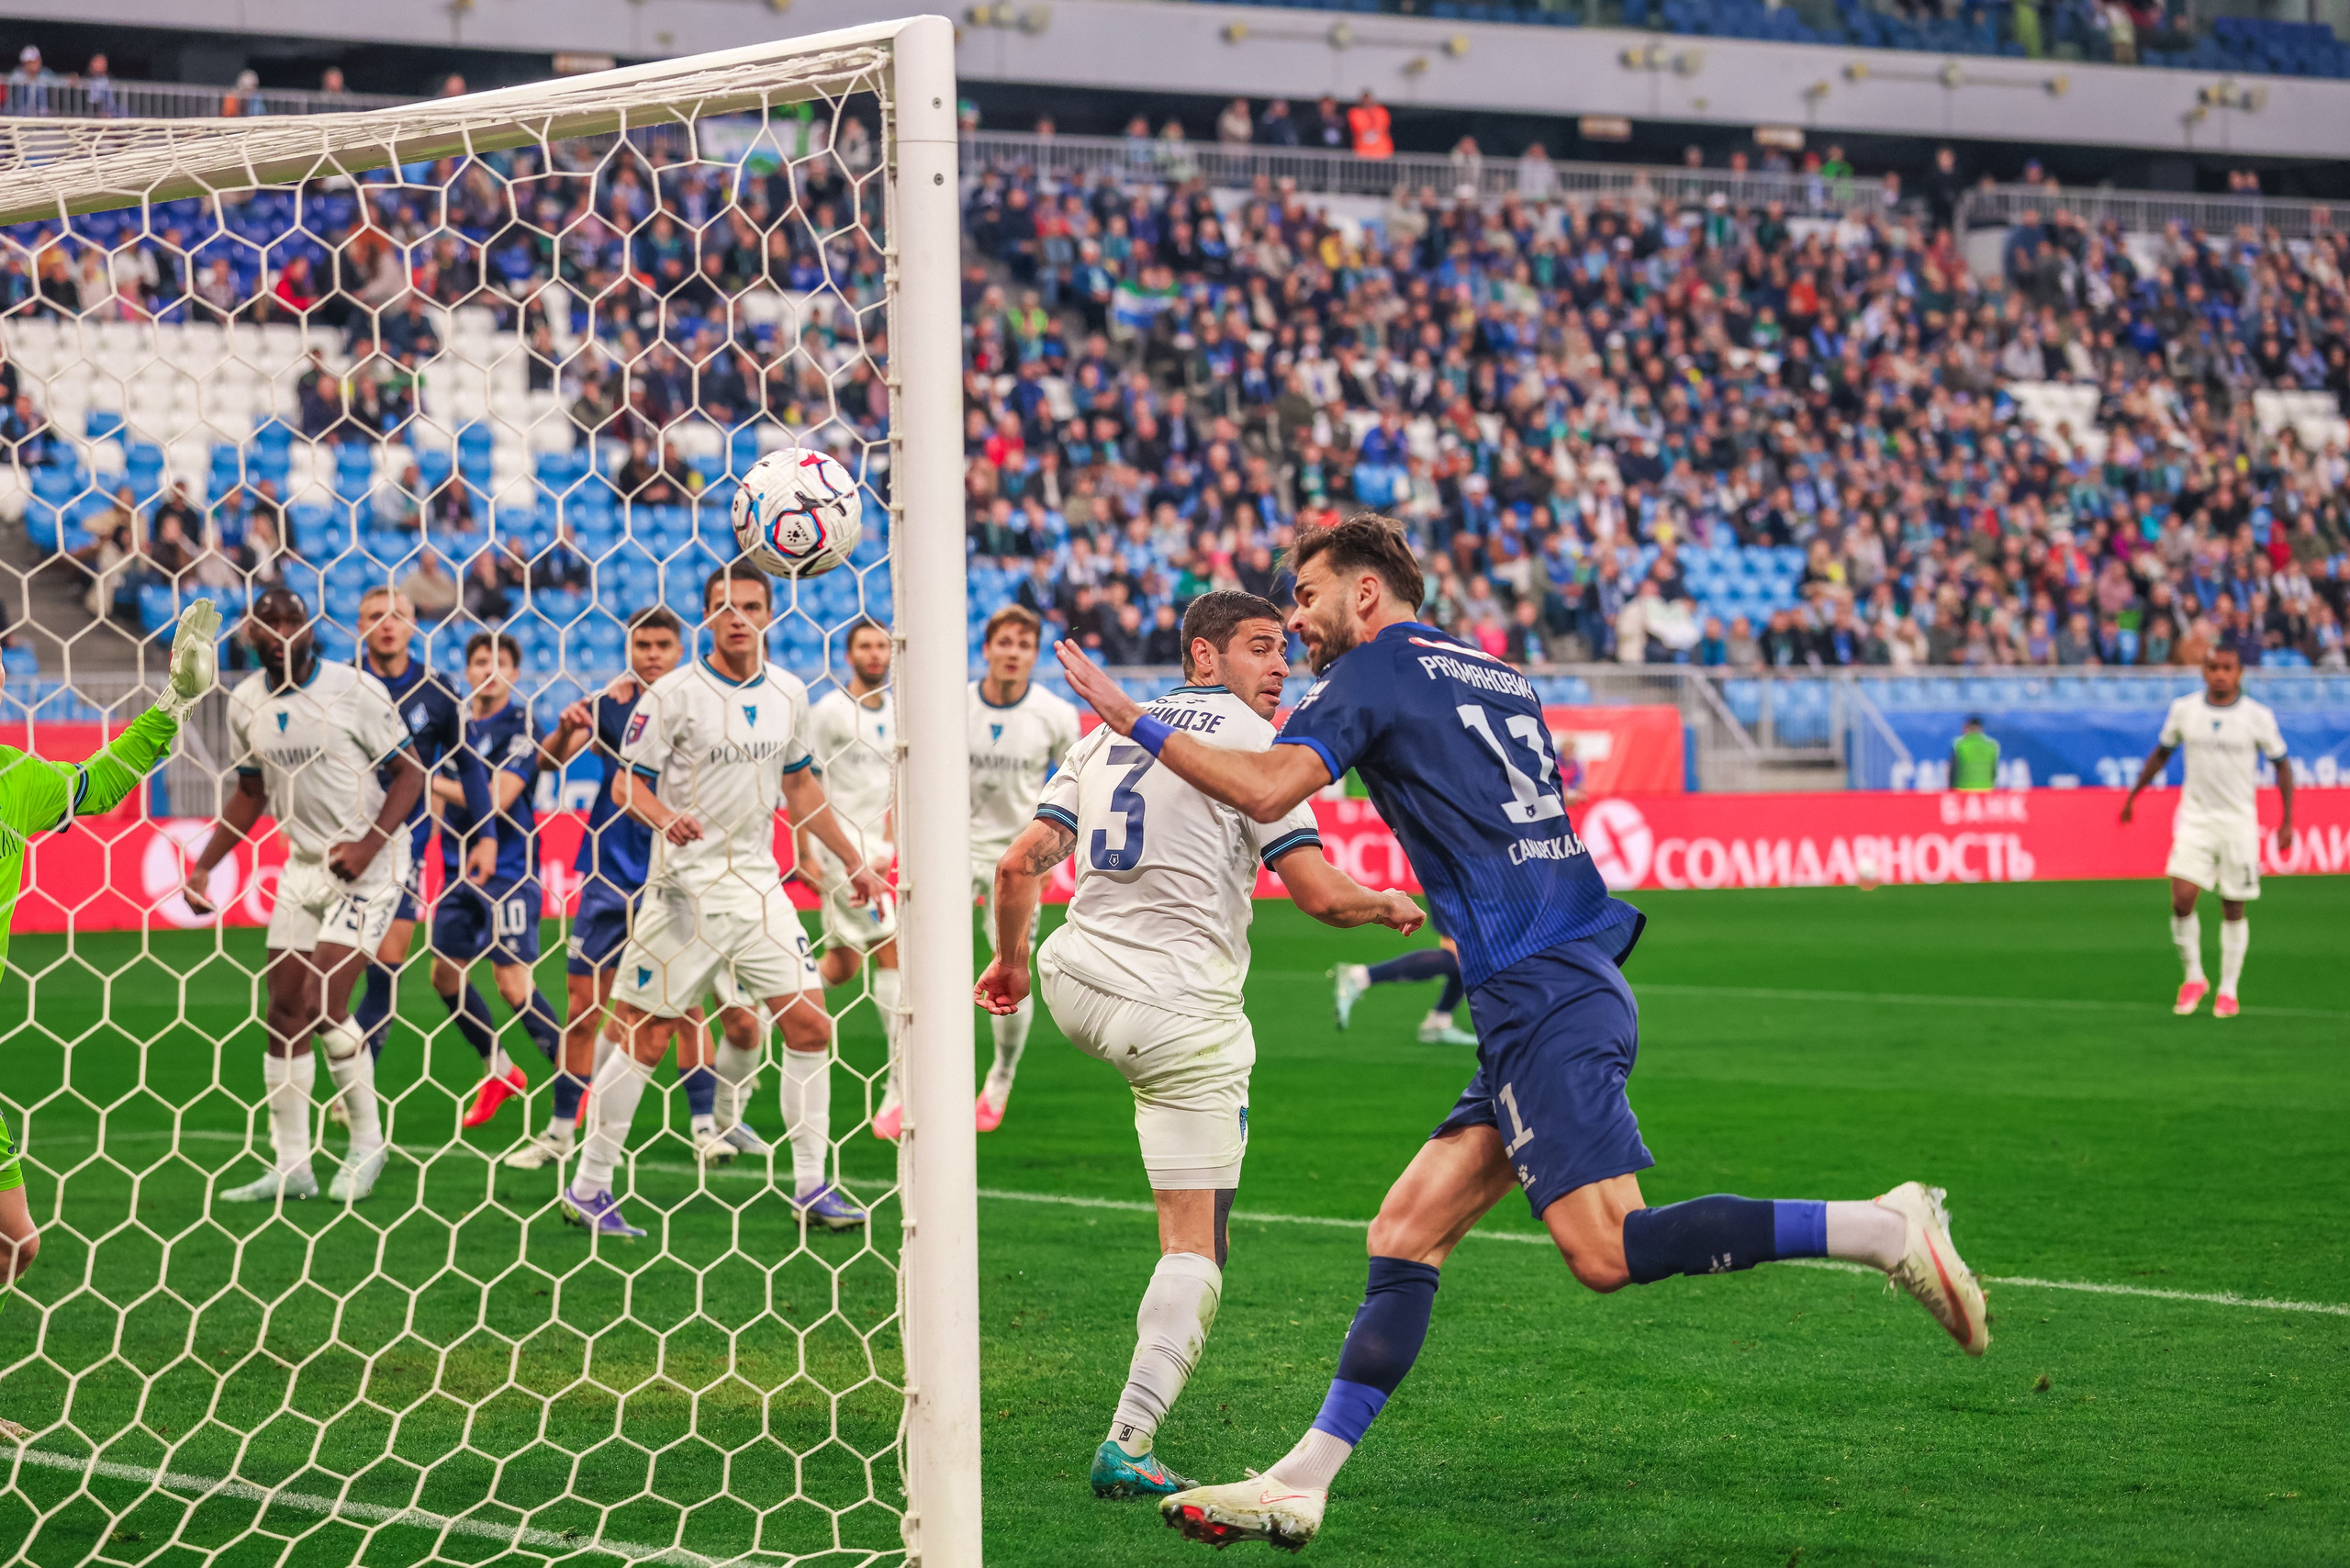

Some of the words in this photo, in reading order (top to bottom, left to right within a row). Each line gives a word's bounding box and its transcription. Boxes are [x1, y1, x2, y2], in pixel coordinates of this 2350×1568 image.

[1090, 745, 1158, 871] 3
[1940, 795, 2029, 825] БАНК
[1654, 833, 2035, 889] СОЛИДАРНОСТЬ
[490, 898, 528, 936] 10
[1492, 1081, 1535, 1159] 1
